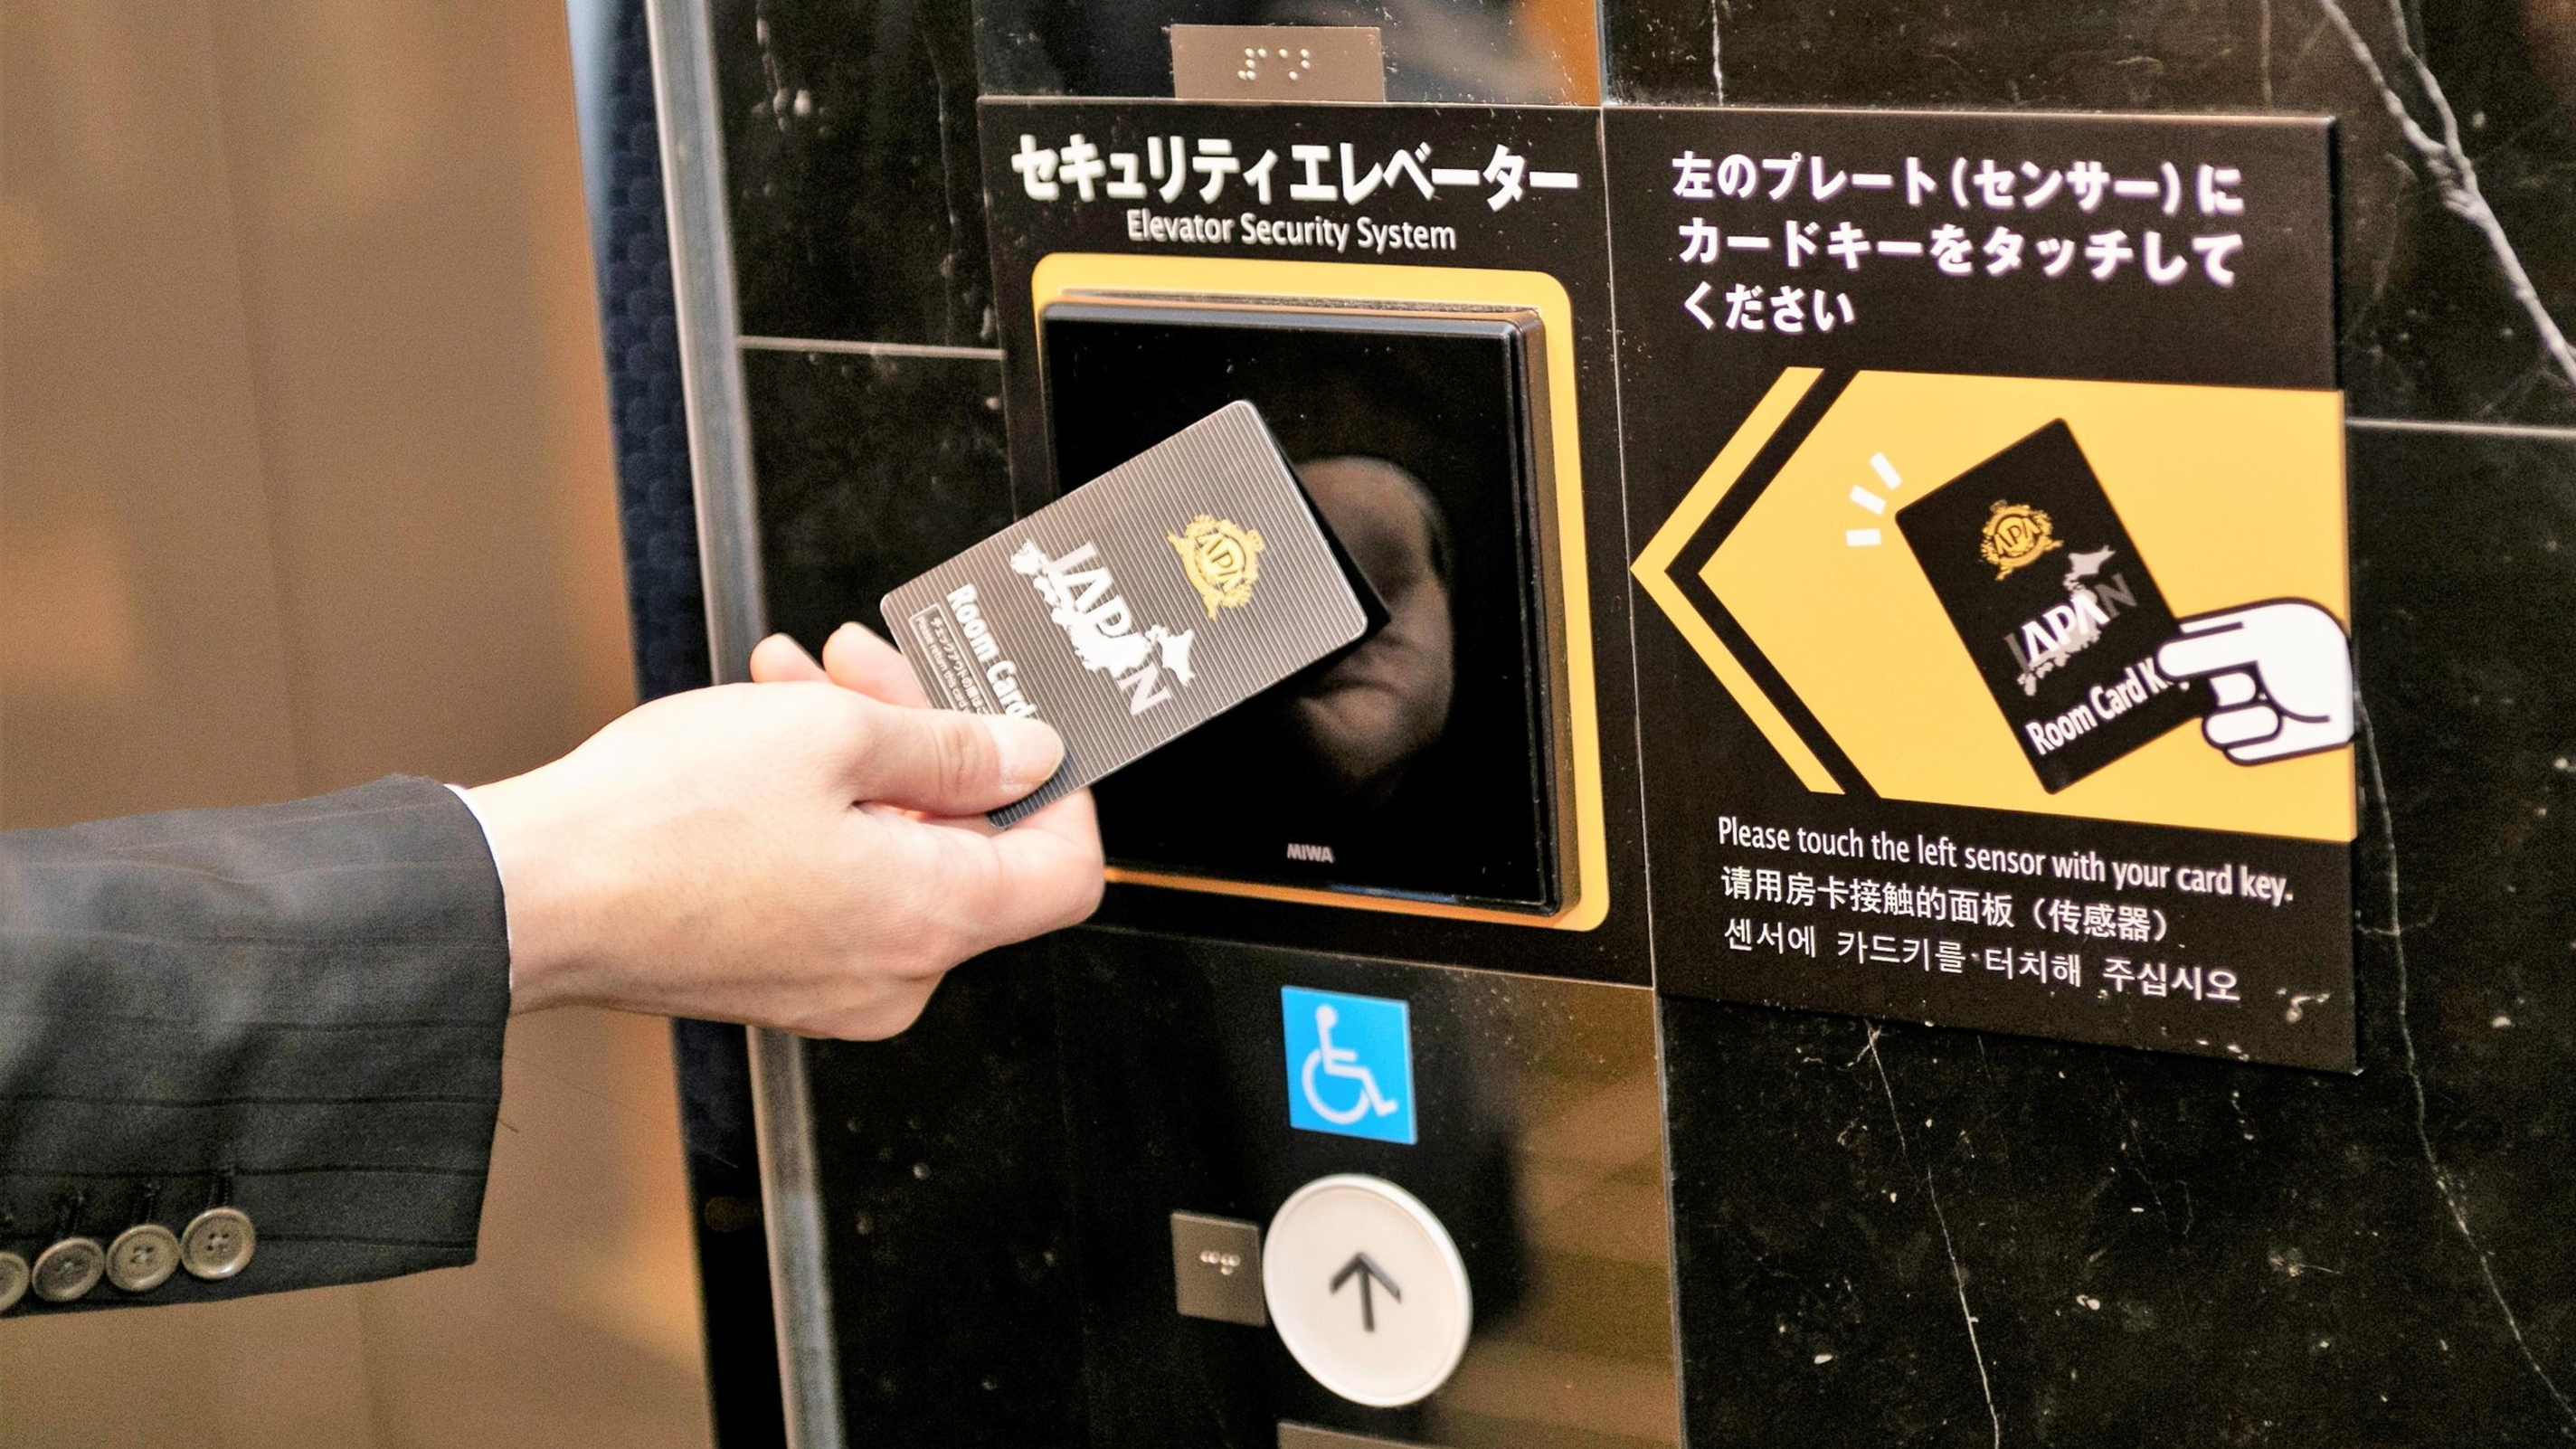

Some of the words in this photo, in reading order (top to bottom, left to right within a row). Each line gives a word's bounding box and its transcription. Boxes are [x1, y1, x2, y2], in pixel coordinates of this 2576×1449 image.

[1010, 133, 1579, 212] セキュリティエレベーター
[1126, 208, 1236, 243] Elevator
[1240, 212, 1350, 253] Security
[1356, 216, 1456, 255] System
[1678, 216, 2245, 287] カードキーをタッチして
[1683, 280, 1855, 334] ください
[946, 582, 999, 664] Room
[985, 659, 1037, 717] Card
[951, 686, 969, 708] card
[2024, 703, 2098, 755] Room
[2088, 668, 2148, 721] Card
[1286, 843, 1335, 864] MIWA
[1718, 816, 1791, 851] Please
[1796, 827, 1864, 858] touch
[1870, 830, 1910, 863] the
[1918, 834, 1958, 868] left
[1965, 847, 2047, 876] sensor
[2050, 850, 2106, 883] with
[2111, 861, 2171, 891] your
[2175, 863, 2233, 895] card
[2240, 865, 2294, 907] key.
[1724, 918, 1816, 959] 센서에
[1837, 931, 1966, 974] 카드키를
[1984, 947, 2081, 988] 터치해
[2102, 957, 2241, 1001] 주십시오
